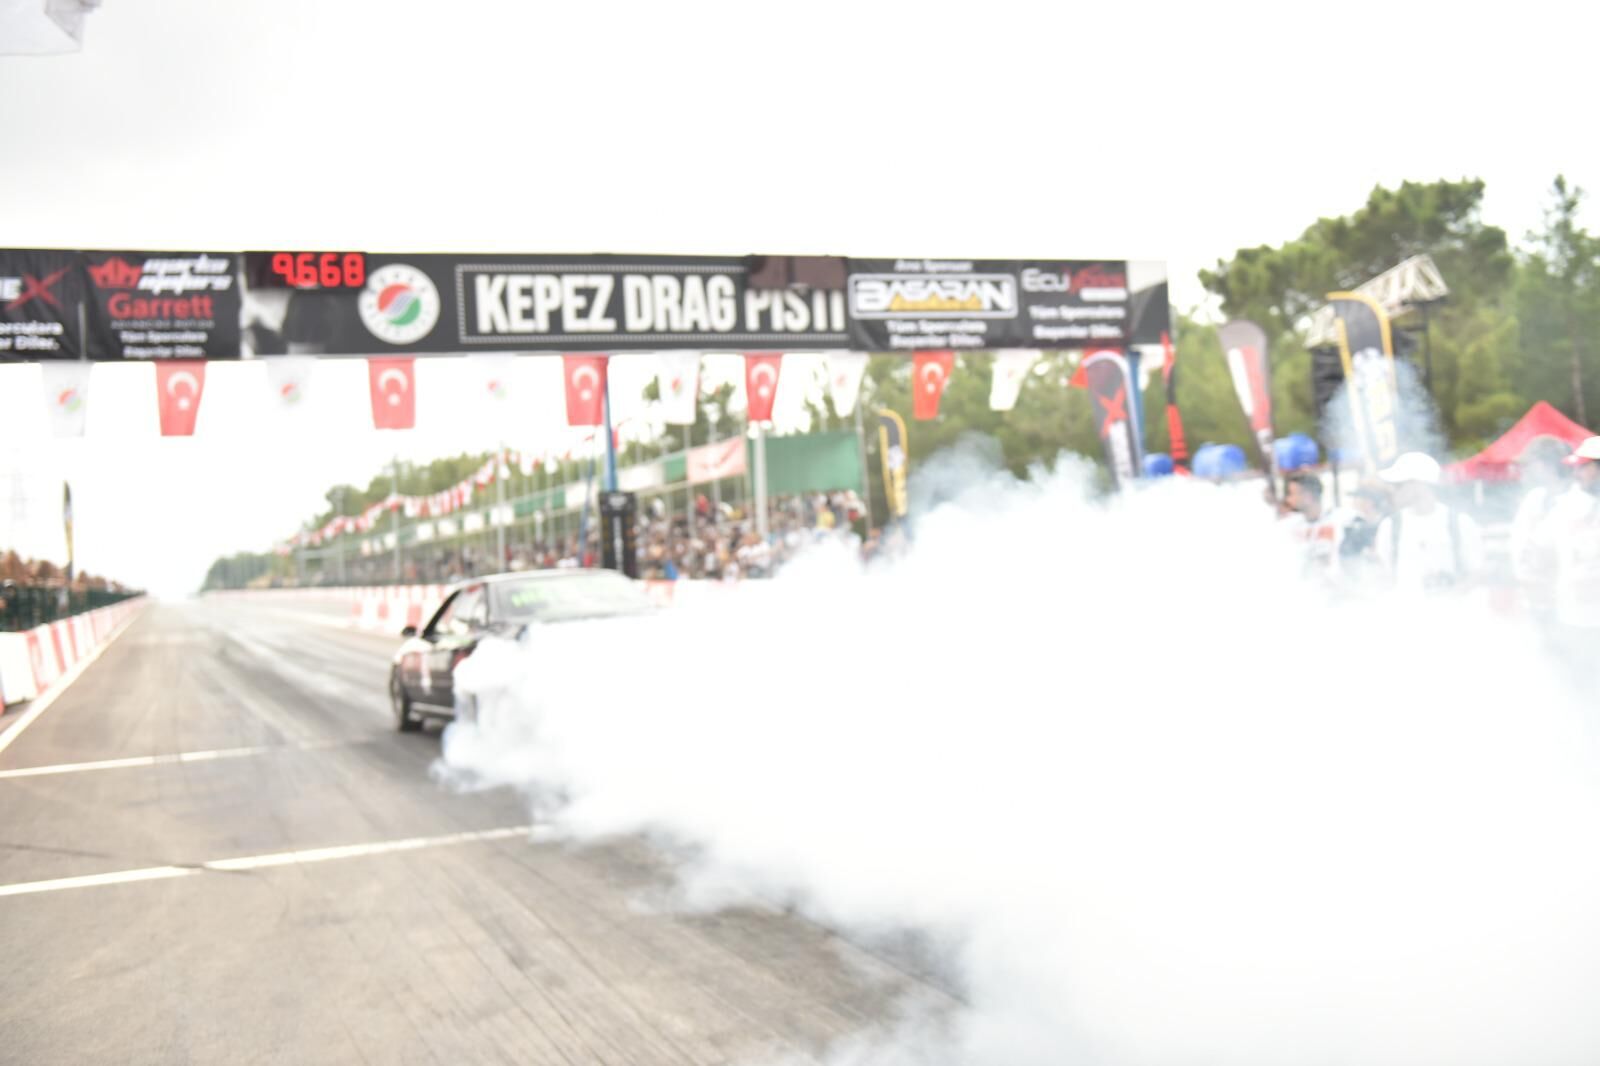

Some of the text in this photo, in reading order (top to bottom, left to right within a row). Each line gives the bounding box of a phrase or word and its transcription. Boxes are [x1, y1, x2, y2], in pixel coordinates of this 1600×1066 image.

[108, 293, 214, 318] Garrett
[475, 275, 616, 333] KEPEZ
[623, 275, 736, 332] DRAG
